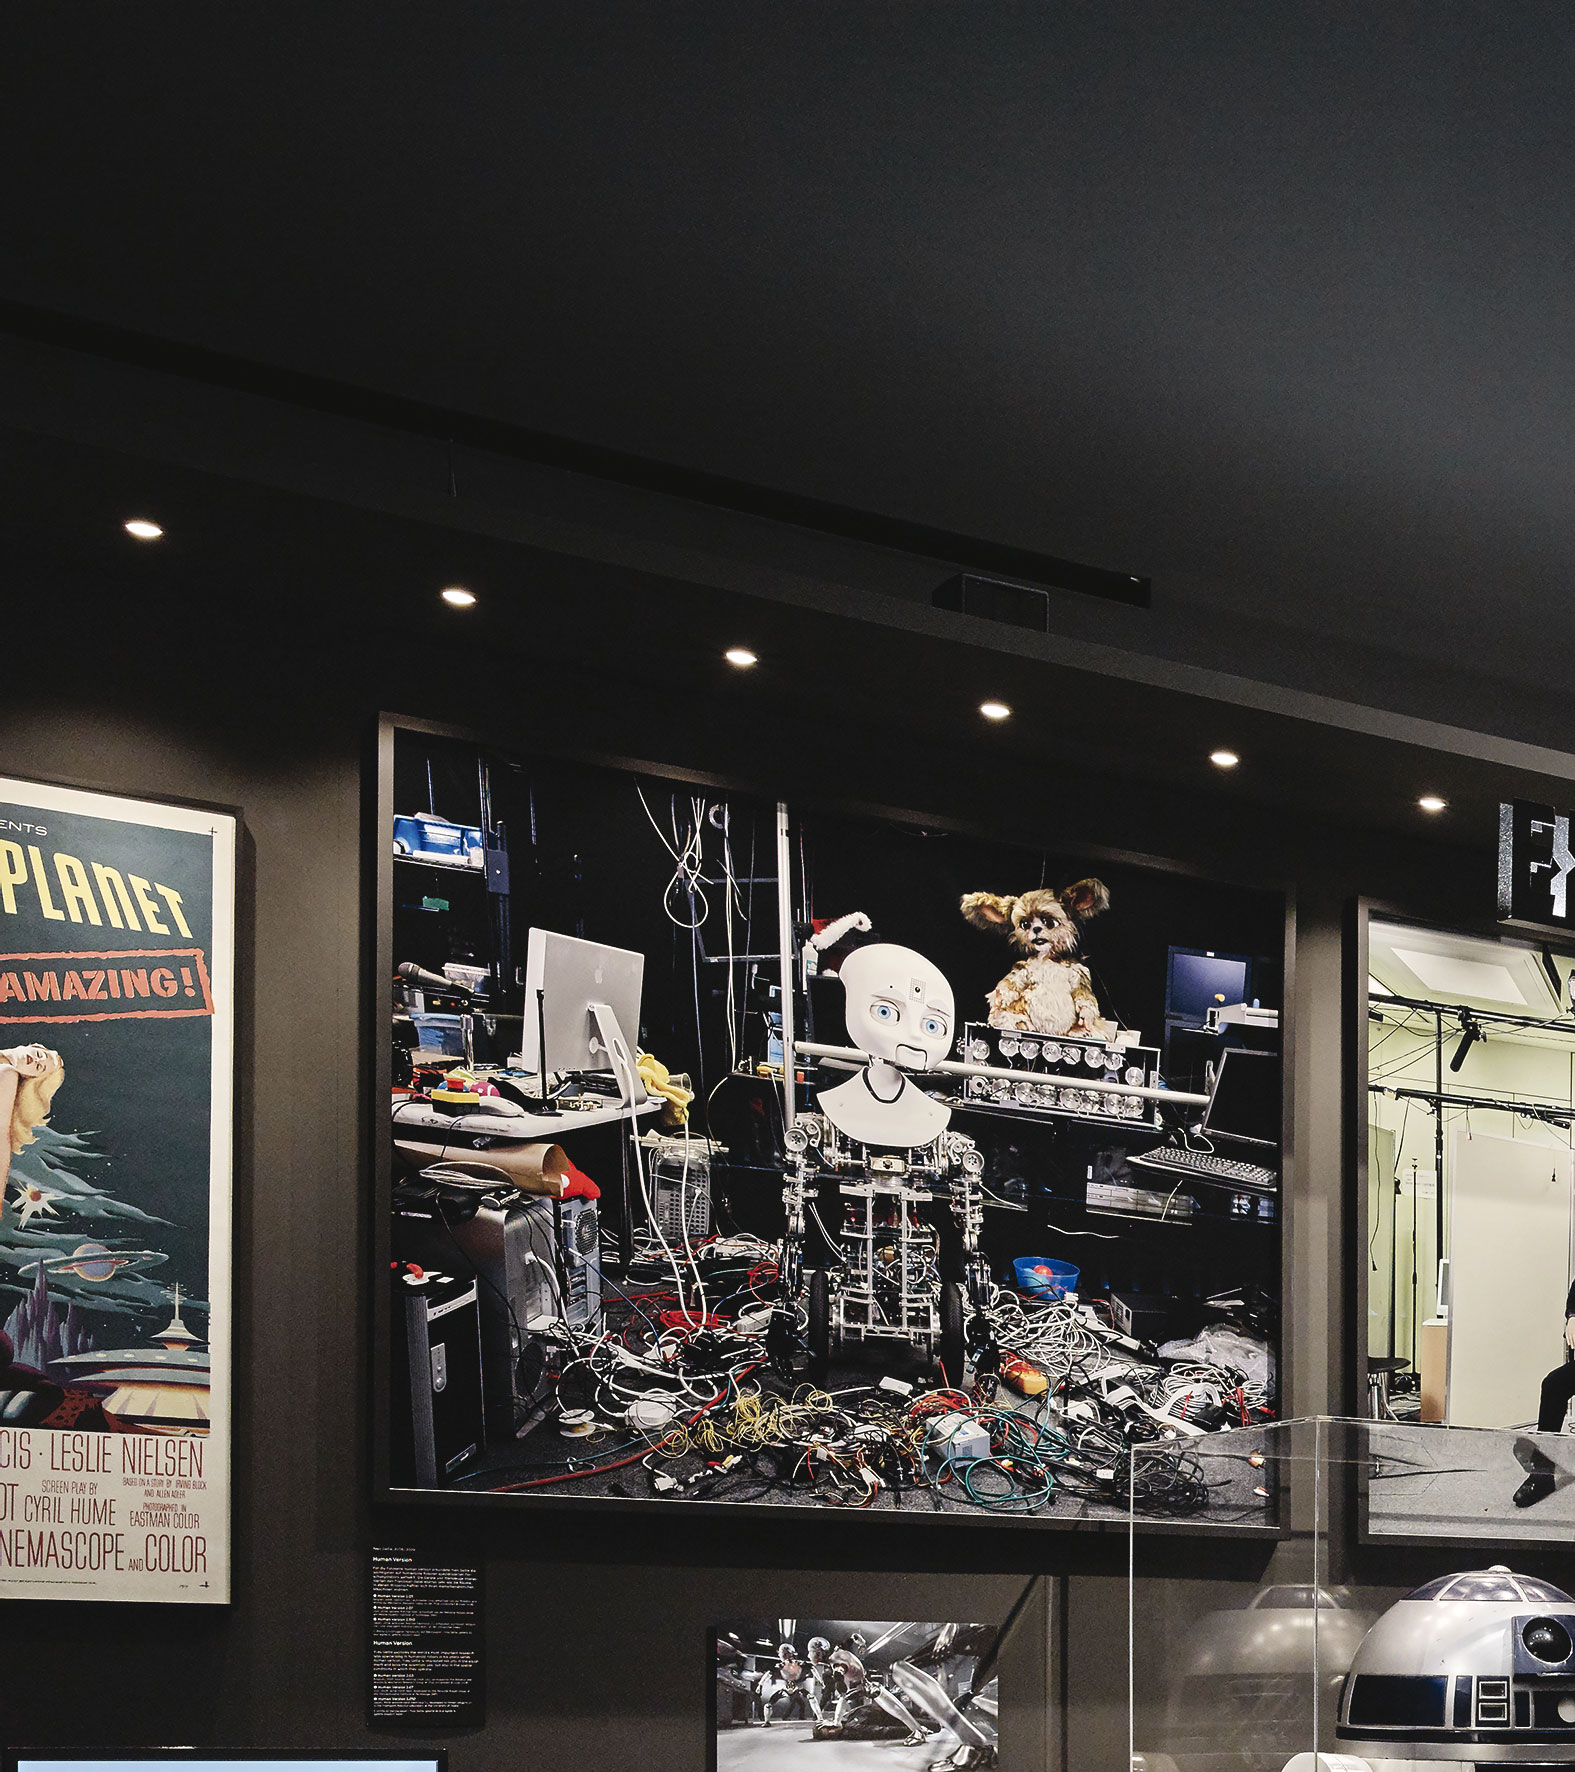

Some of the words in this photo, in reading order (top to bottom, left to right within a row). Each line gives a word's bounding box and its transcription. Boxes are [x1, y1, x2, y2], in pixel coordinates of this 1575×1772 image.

[0, 838, 193, 938] PLANET
[0, 967, 196, 1002] AMAZING!
[51, 1433, 111, 1473] LESLIE
[123, 1437, 203, 1478] NIELSEN
[42, 1480, 69, 1494] SCREEN
[72, 1481, 87, 1495] PLAY
[89, 1482, 98, 1495] BY
[144, 1489, 154, 1497] AND
[156, 1490, 170, 1498] ALLEN
[171, 1490, 186, 1499] ADLER
[24, 1494, 64, 1524] CYRIL
[70, 1498, 116, 1526] HUME
[130, 1511, 170, 1528] EASTMAN
[173, 1513, 200, 1529] COLOR
[128, 1558, 143, 1571] AND
[145, 1534, 207, 1573] COLOR
